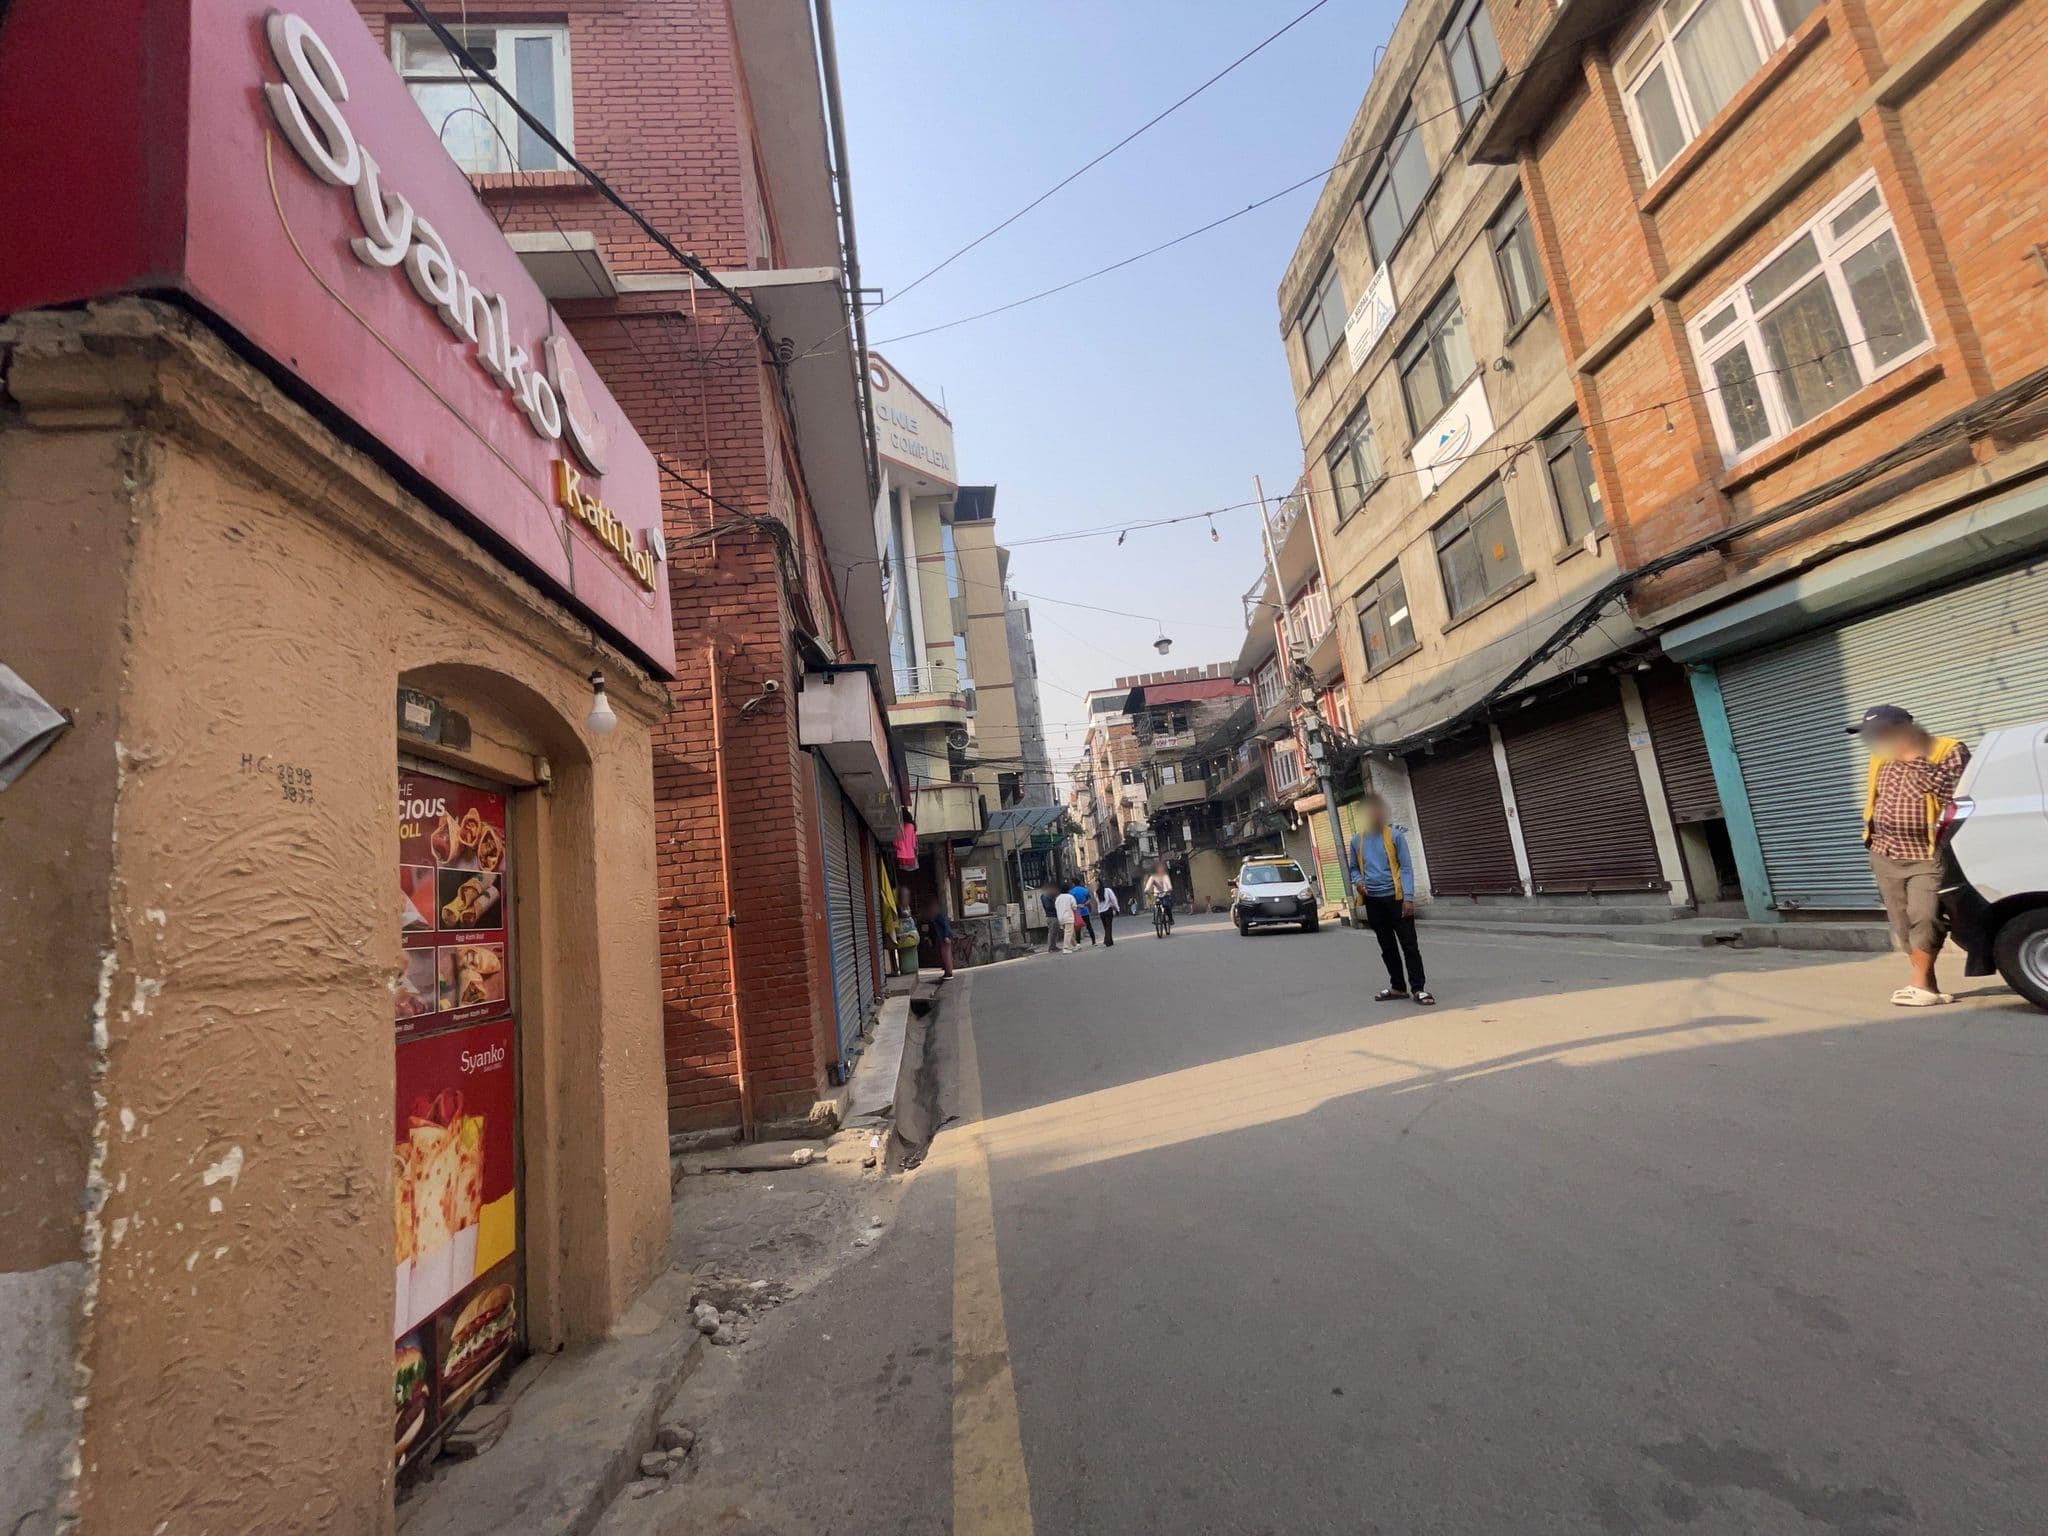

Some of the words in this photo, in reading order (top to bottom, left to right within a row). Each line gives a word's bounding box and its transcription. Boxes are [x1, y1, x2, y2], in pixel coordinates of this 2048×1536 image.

[264, 12, 563, 441] Syanko
[890, 430, 950, 471] COMPLEX
[622, 519, 656, 592] Roll
[460, 1043, 505, 1074] Syanko
